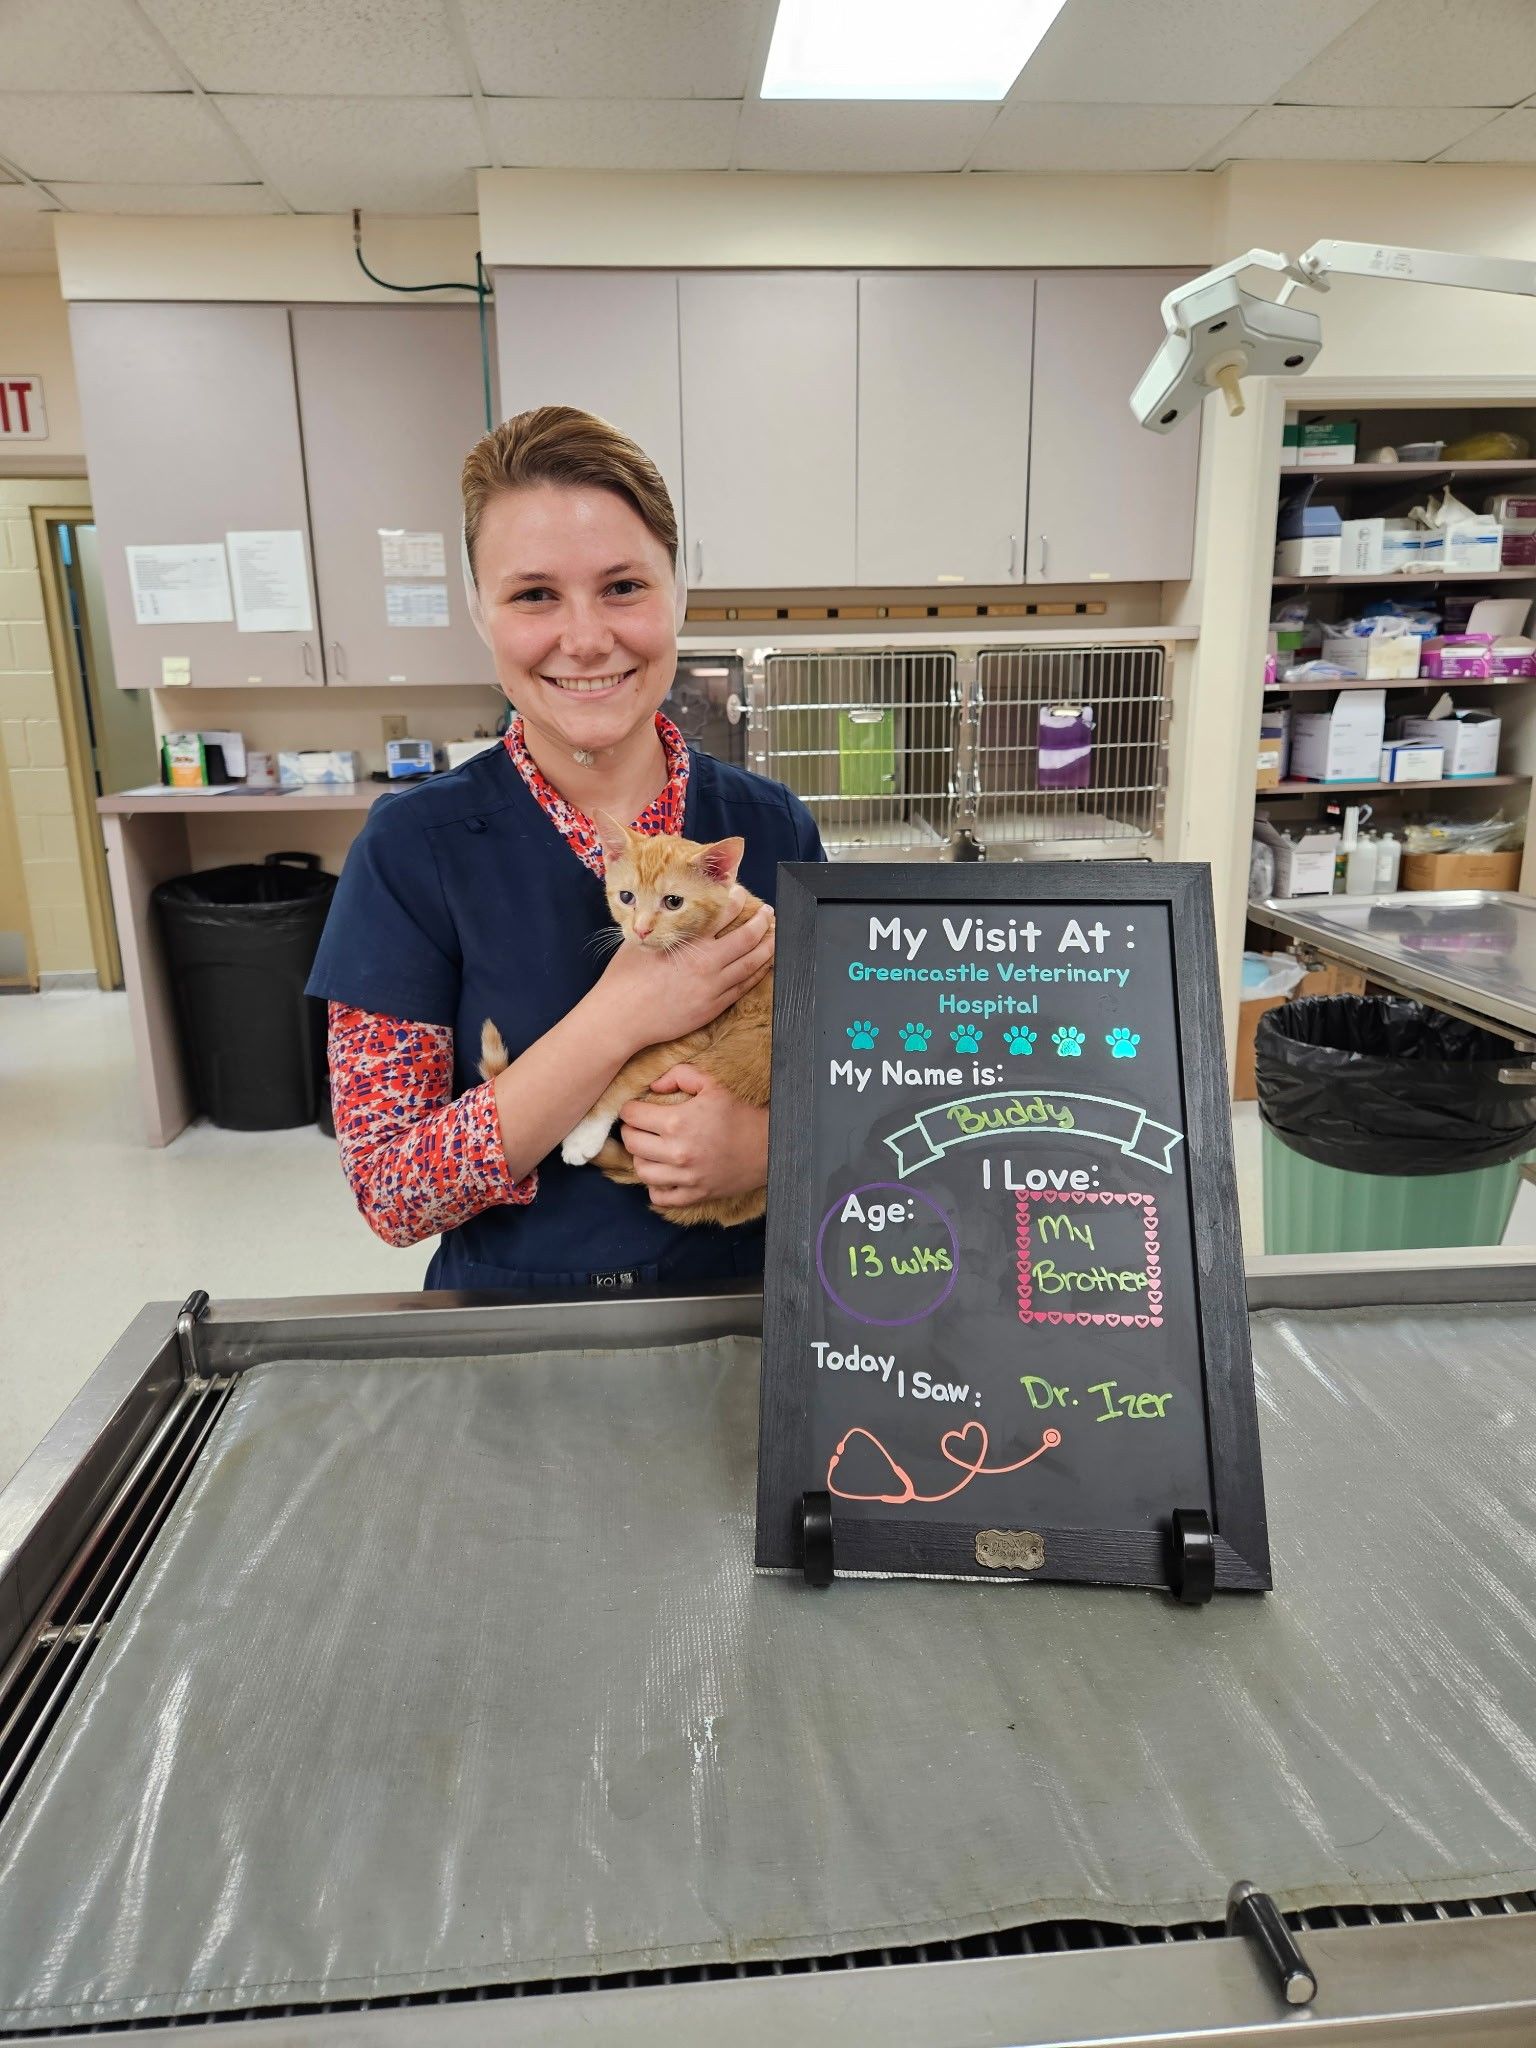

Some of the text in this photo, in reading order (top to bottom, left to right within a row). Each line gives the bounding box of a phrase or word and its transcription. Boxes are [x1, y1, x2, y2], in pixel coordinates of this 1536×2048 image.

[869, 917, 927, 960] My
[943, 918, 1042, 953] Visit
[1058, 920, 1111, 954] At
[848, 961, 1130, 987] Greencastle Veterinary
[938, 994, 1039, 1019] Hospital
[830, 1060, 1004, 1092] My Name is:
[947, 1096, 1075, 1134] Buddy
[983, 1159, 1100, 1190] I Love:
[841, 1194, 915, 1232] Age:
[1037, 1214, 1095, 1251] My
[848, 1244, 954, 1278] 13 wks
[596, 1273, 616, 1289] koi
[810, 1341, 895, 1382] Today
[898, 1370, 905, 1398] I
[1020, 1375, 1173, 1423] Dr. Izer
